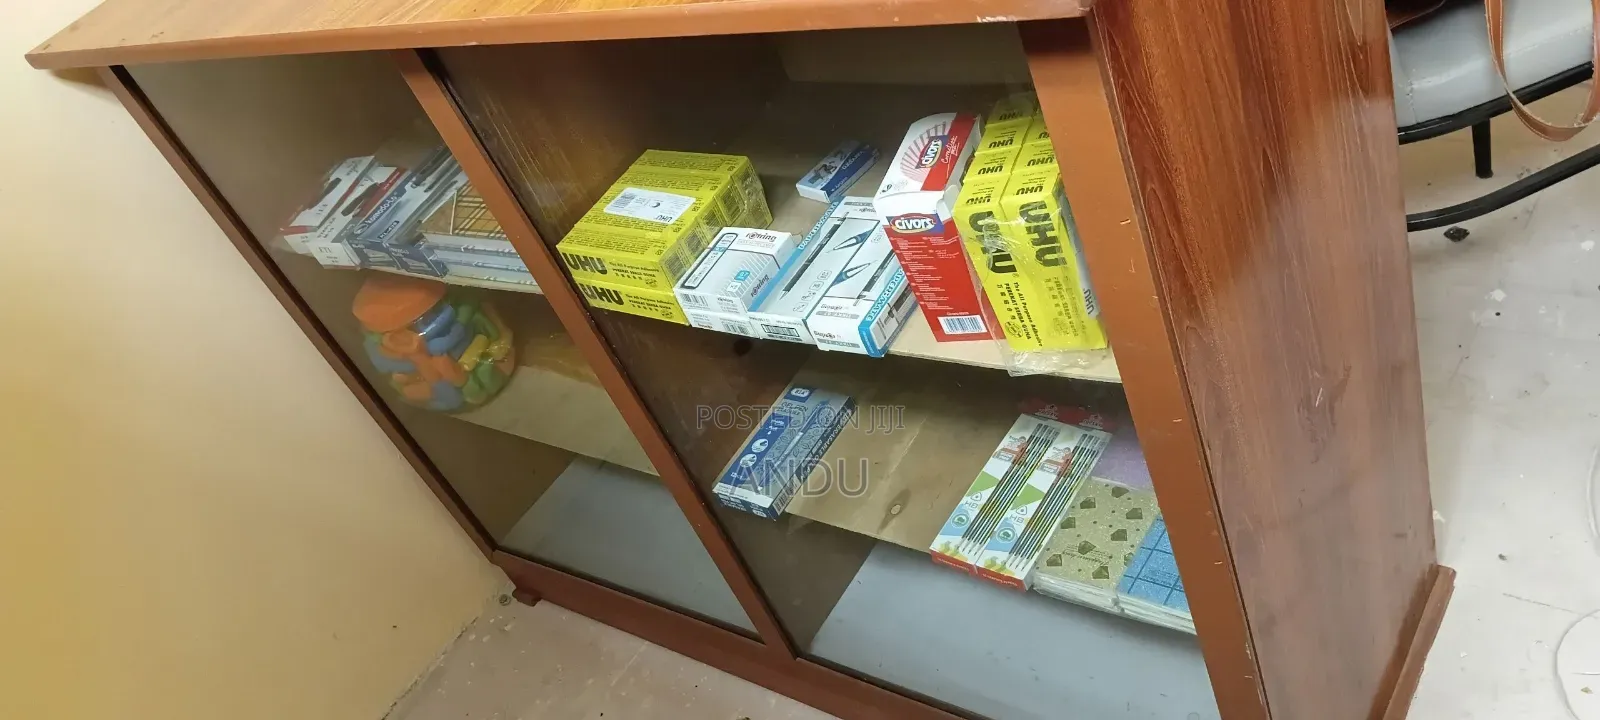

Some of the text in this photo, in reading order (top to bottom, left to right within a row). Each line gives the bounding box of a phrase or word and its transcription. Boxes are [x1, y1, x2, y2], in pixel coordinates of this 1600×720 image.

[988, 138, 1014, 148] UHU
[1027, 156, 1055, 167] UHU
[978, 165, 1004, 175] UHU
[1015, 185, 1044, 196] UHU
[966, 195, 991, 205] UHU
[1018, 200, 1068, 268] UHU
[561, 251, 608, 275] UHU
[577, 282, 625, 306] UHU
